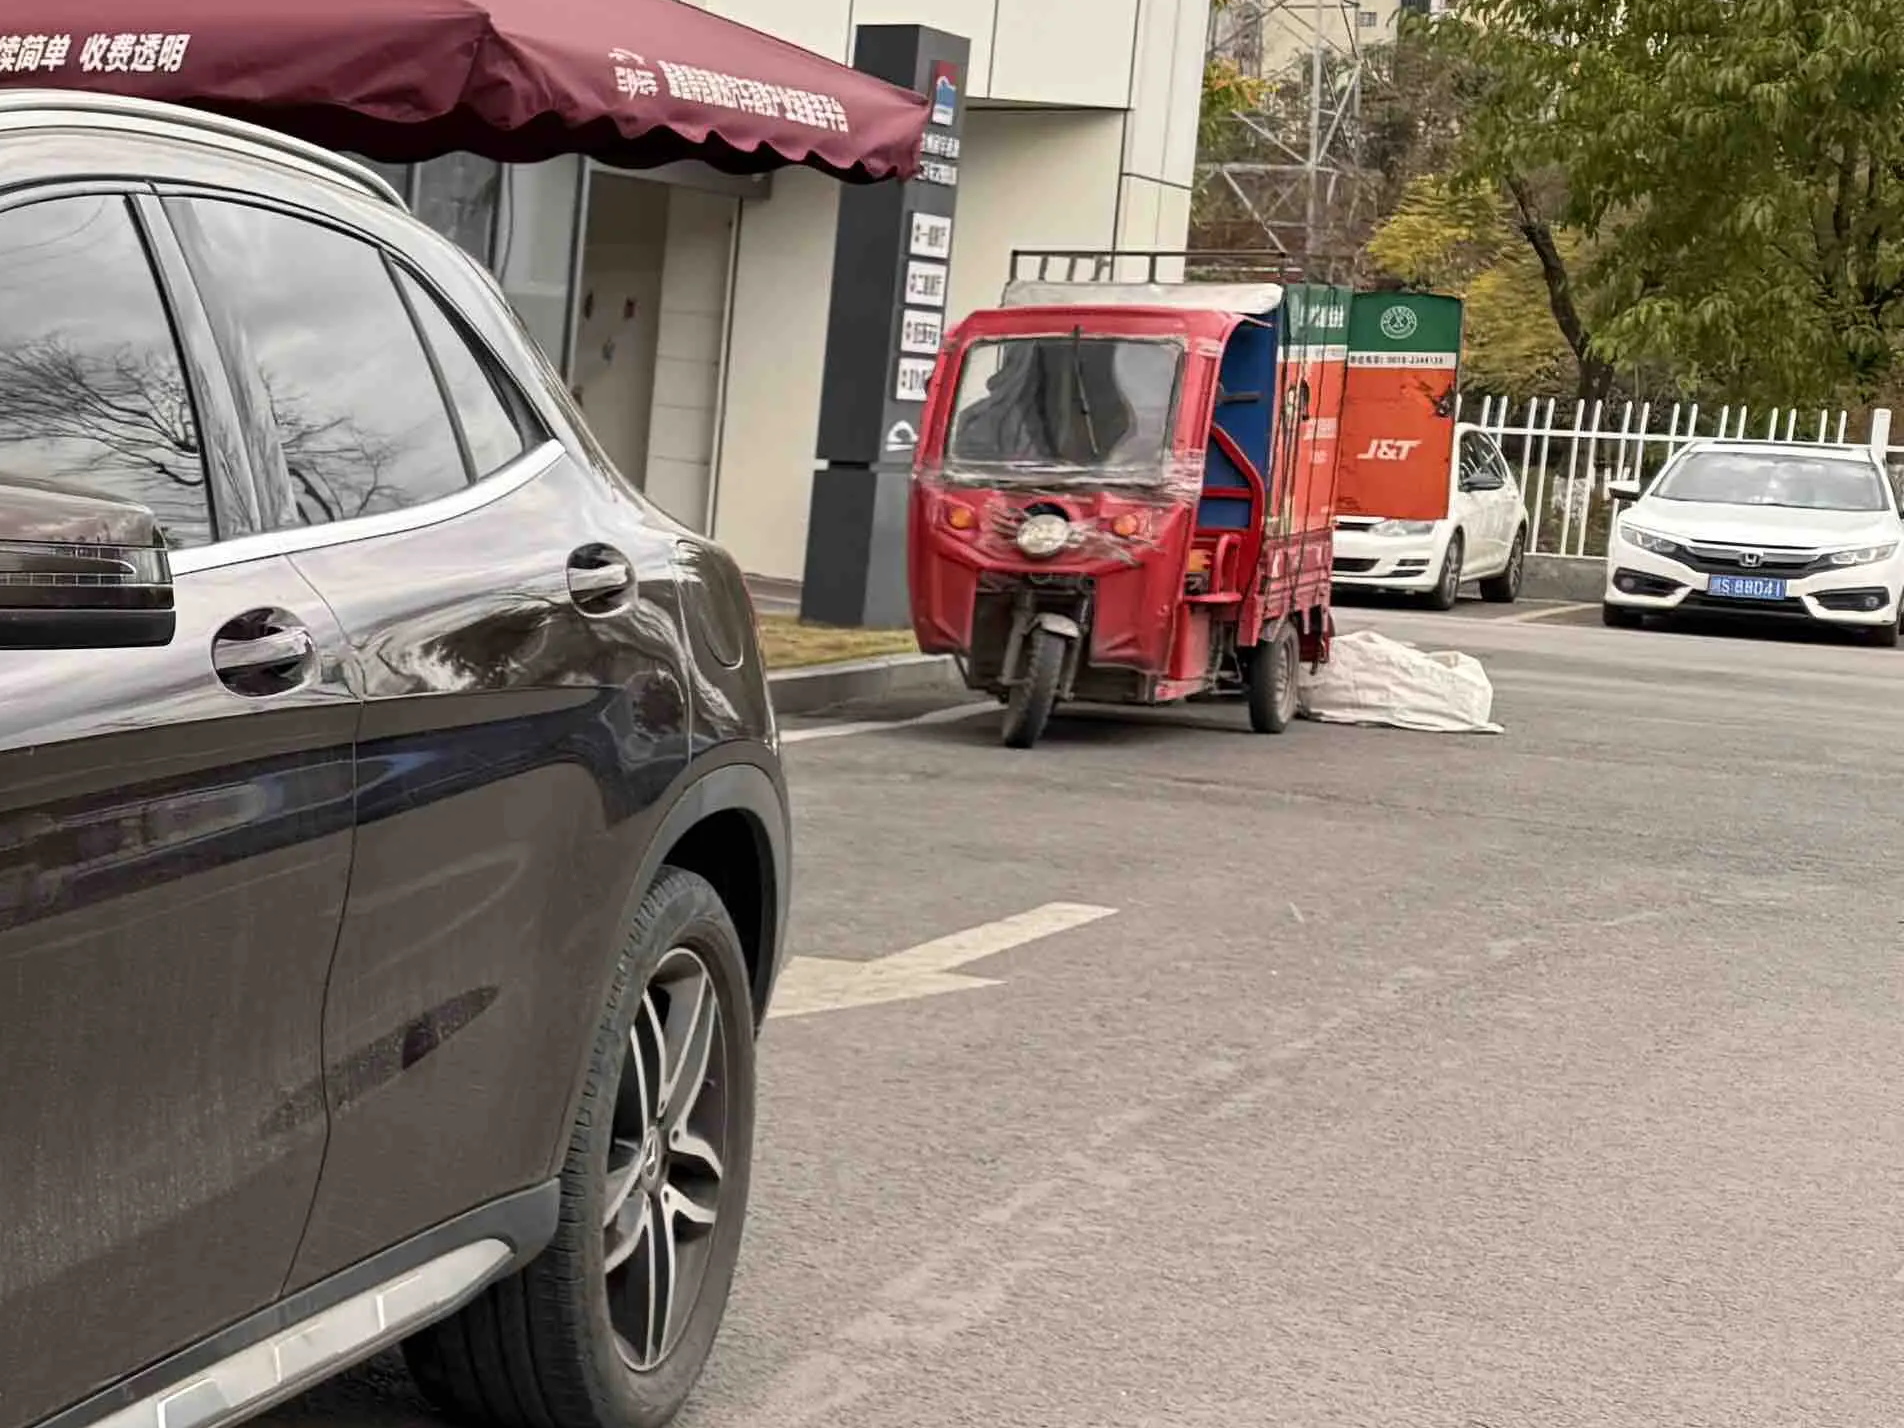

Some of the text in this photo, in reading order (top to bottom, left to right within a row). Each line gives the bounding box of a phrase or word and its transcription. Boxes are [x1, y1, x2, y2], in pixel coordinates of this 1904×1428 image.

[79, 33, 191, 73] 收费透明
[1357, 439, 1422, 461] J&T
